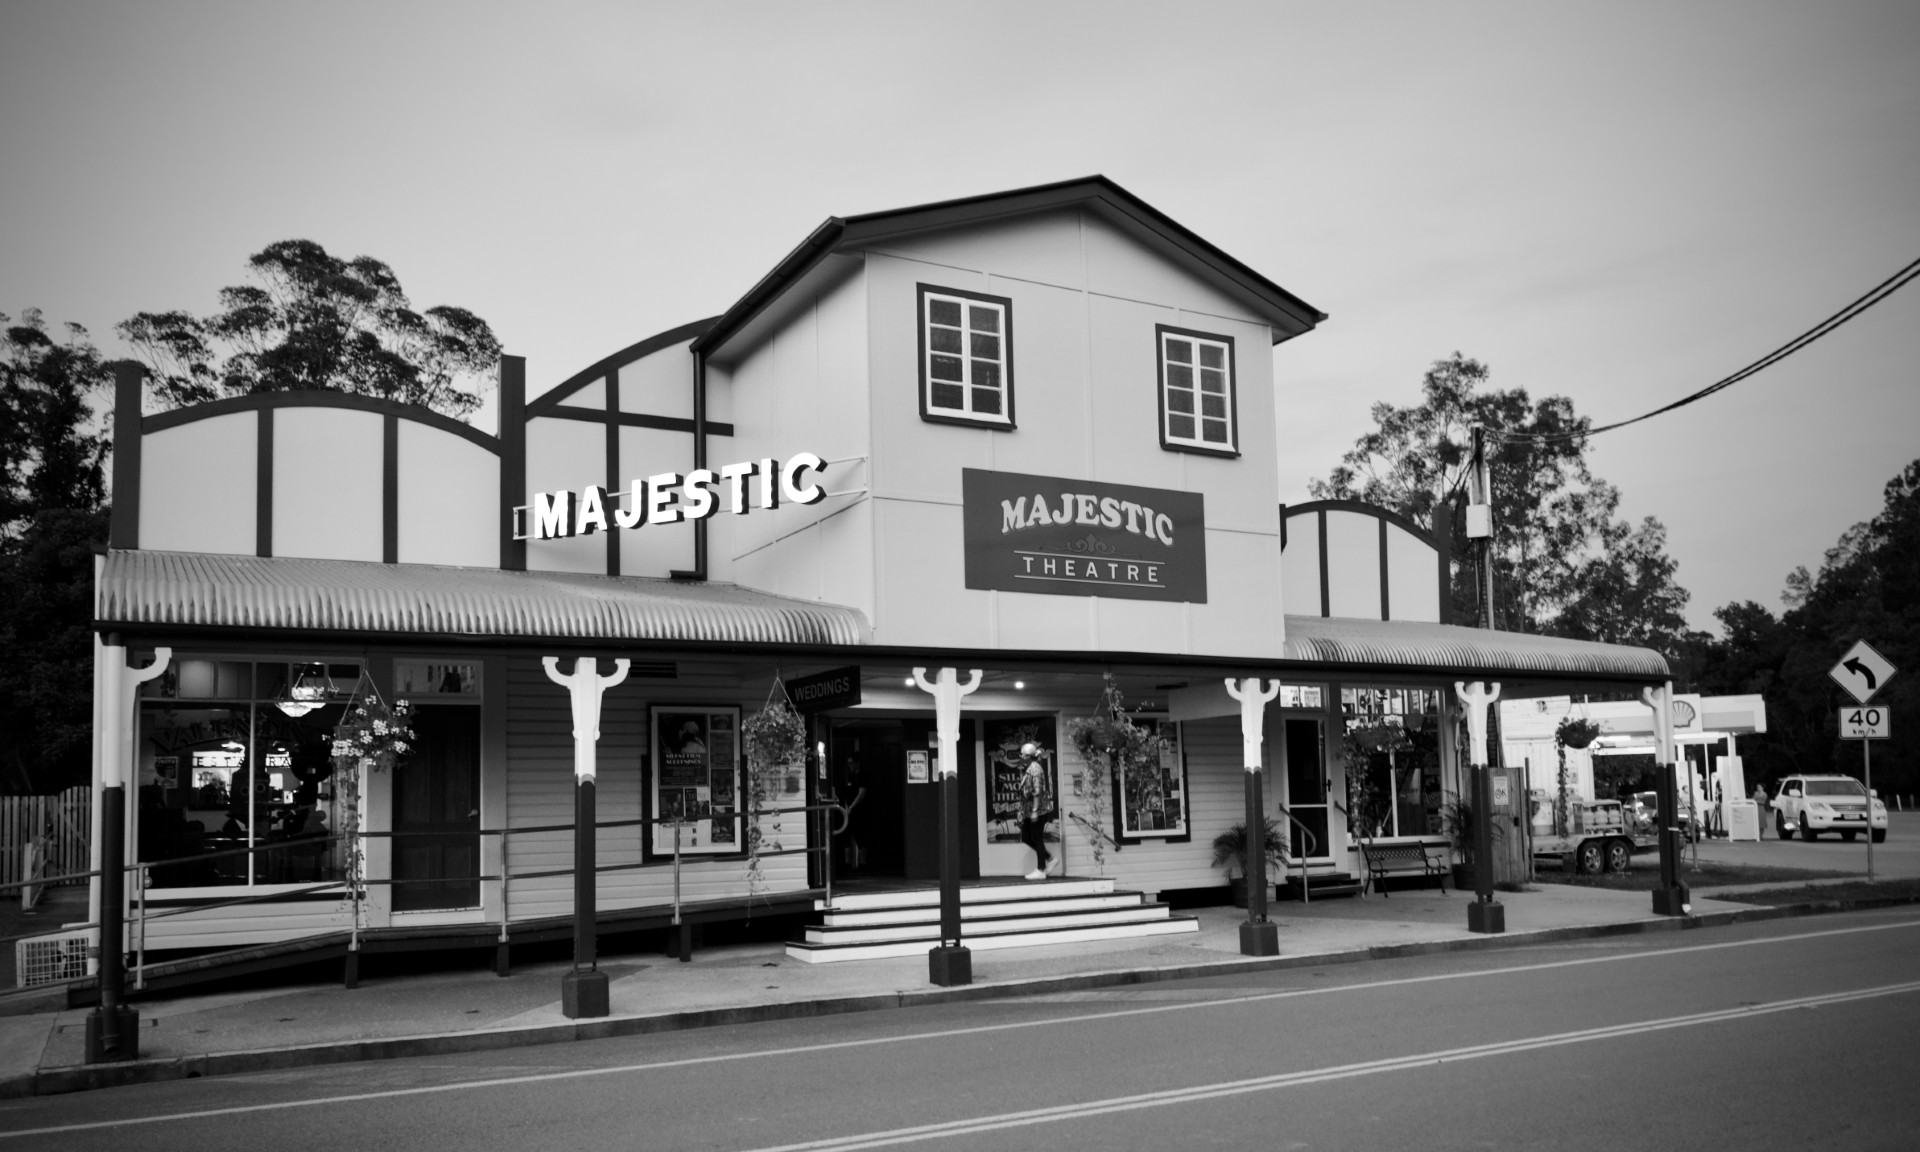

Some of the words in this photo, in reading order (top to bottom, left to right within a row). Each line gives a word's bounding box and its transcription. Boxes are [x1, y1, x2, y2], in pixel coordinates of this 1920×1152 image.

[534, 452, 828, 539] MAJESTIC
[1001, 493, 1174, 546] MAJESTIC
[1022, 556, 1158, 582] THEATRE
[794, 676, 850, 702] WEDDINGS
[1848, 709, 1880, 726] 40
[1852, 728, 1876, 737] km/h
